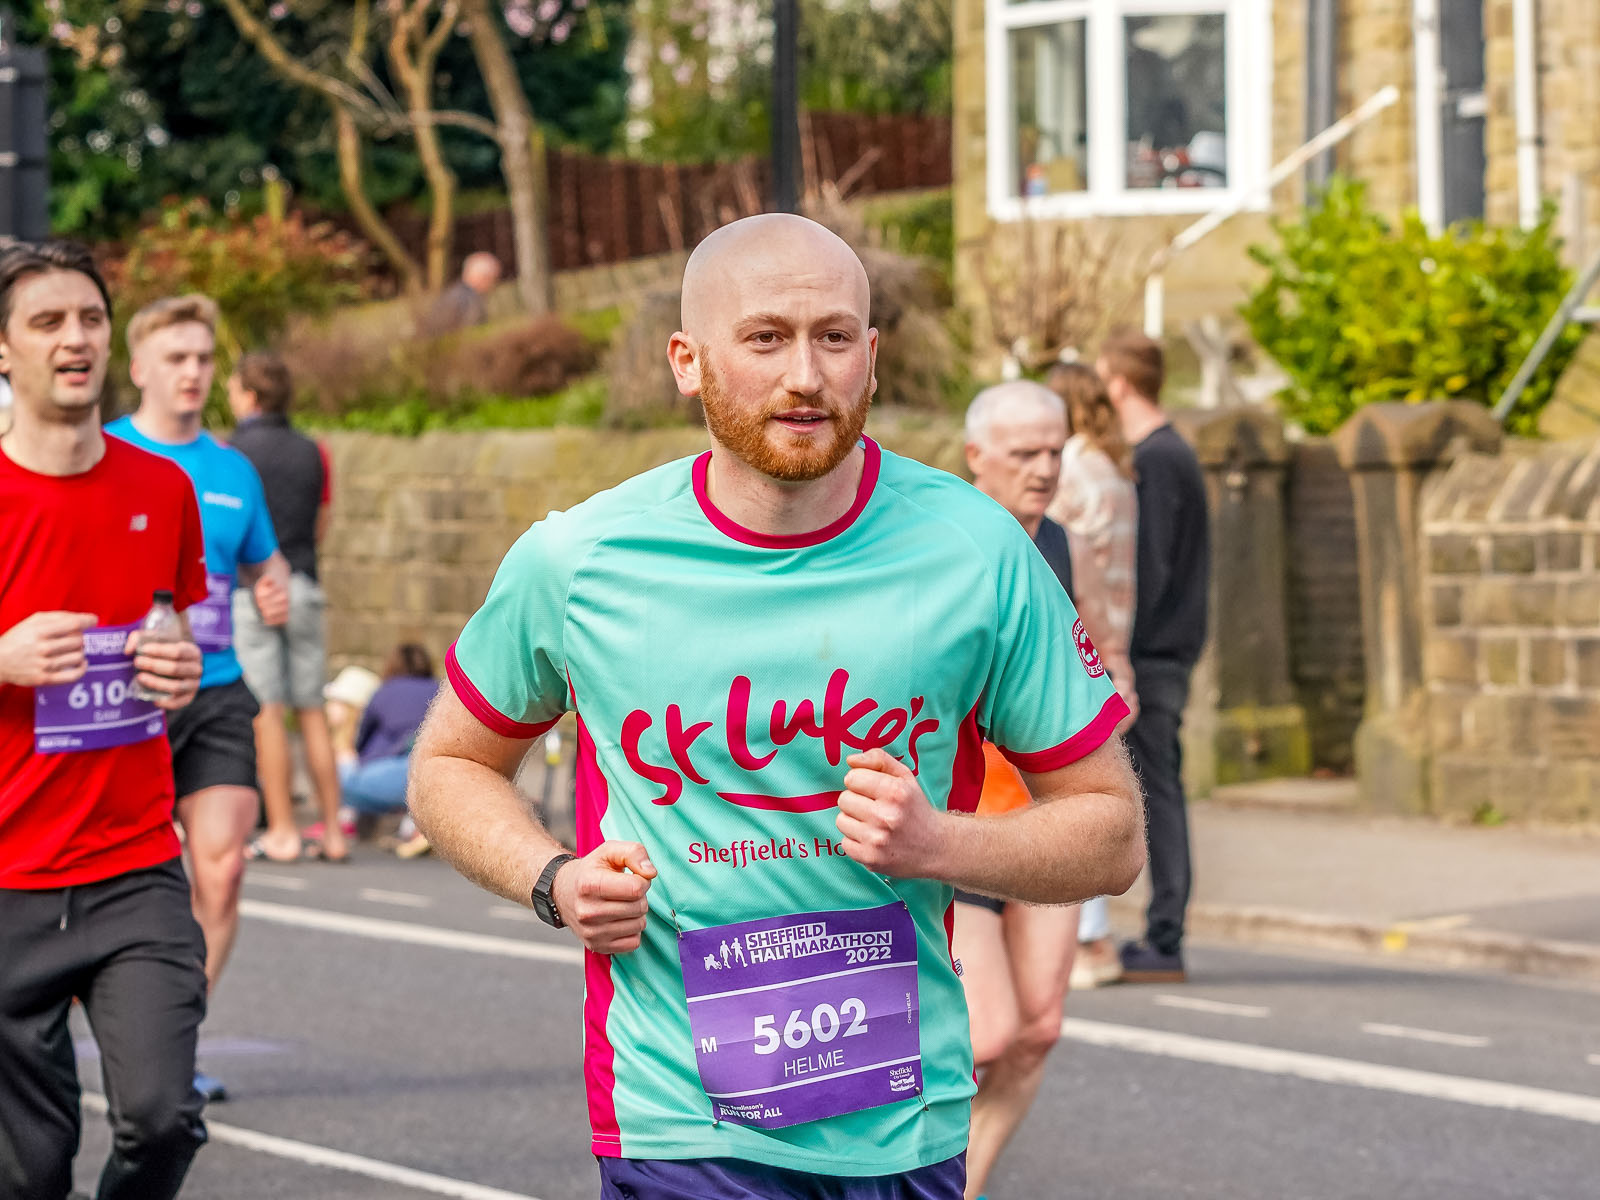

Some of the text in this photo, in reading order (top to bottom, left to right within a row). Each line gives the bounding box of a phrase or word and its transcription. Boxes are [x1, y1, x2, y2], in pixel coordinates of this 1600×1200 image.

[726, 668, 940, 776] Luke's
[688, 837, 809, 868] Sheffield's
[747, 924, 824, 948] SHEFFIELD
[750, 932, 890, 964] HALF MARATHON
[845, 946, 892, 965] 2022
[753, 997, 868, 1056] 5602
[700, 1036, 718, 1054] M
[784, 1049, 845, 1078] HELME
[889, 1066, 913, 1076] Sheffield
[720, 1106, 783, 1120] RUN FOR ALL
[730, 1102, 764, 1111] Tomlinson's
